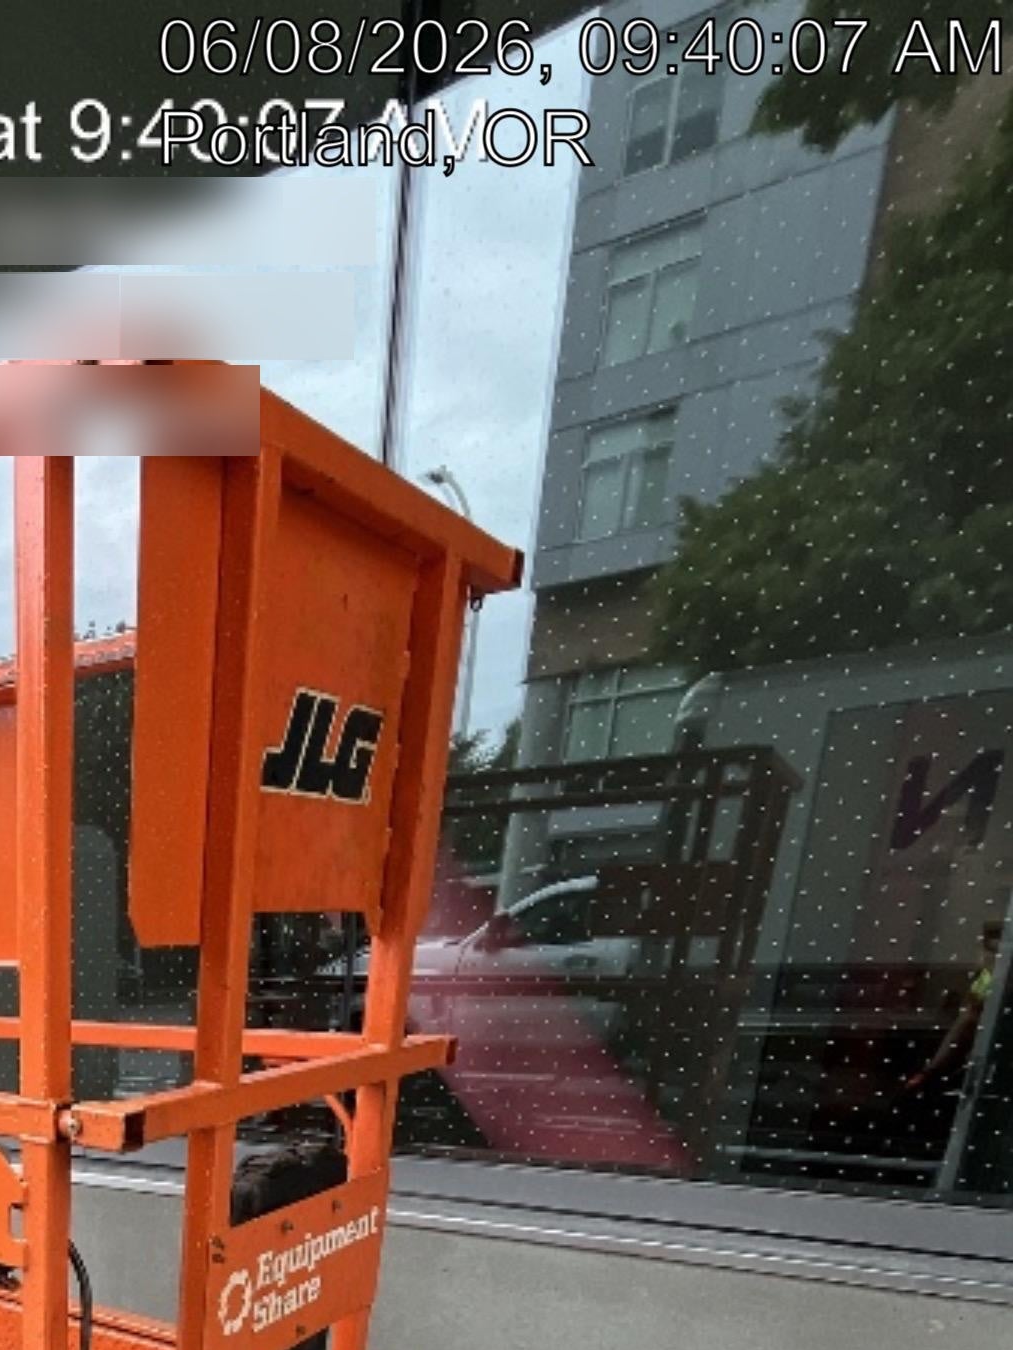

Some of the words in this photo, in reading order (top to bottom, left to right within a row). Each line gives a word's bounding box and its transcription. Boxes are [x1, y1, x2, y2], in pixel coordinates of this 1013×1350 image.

[259, 686, 385, 806] JLG
[255, 1205, 380, 1290] Equipment
[251, 1275, 322, 1333] Share
